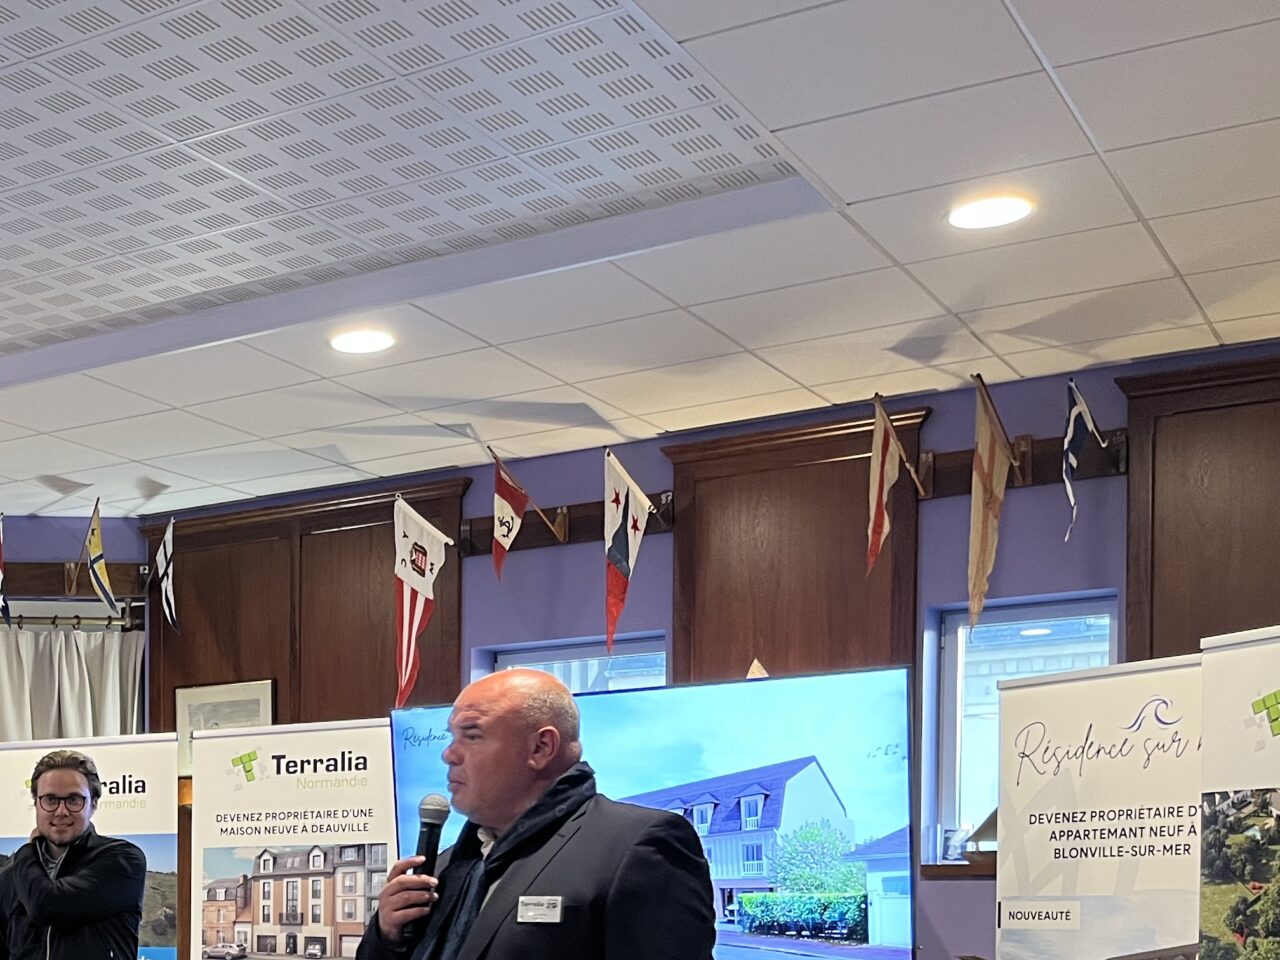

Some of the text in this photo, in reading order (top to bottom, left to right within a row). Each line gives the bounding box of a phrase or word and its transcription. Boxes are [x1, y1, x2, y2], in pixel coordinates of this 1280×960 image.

[1014, 721, 1189, 786] Résidence sur
[271, 750, 368, 775] Terralia
[296, 775, 368, 790] Normandie
[100, 798, 146, 809] rmandie
[216, 808, 374, 823] DEVENEZ PROPRIÉTAIRE D'UNE
[1028, 805, 1185, 825] DEVENEZ PROPRIÉTAIRE
[220, 826, 262, 837] MAISON
[264, 825, 299, 835] NEUVE
[311, 822, 369, 833] DEAUVILLE
[1048, 821, 1198, 842] APPARTEMANT NEUF À
[1053, 844, 1192, 860] BLONVILLE-SUR-MER
[1008, 908, 1072, 921] NOUVEAUTÉ
